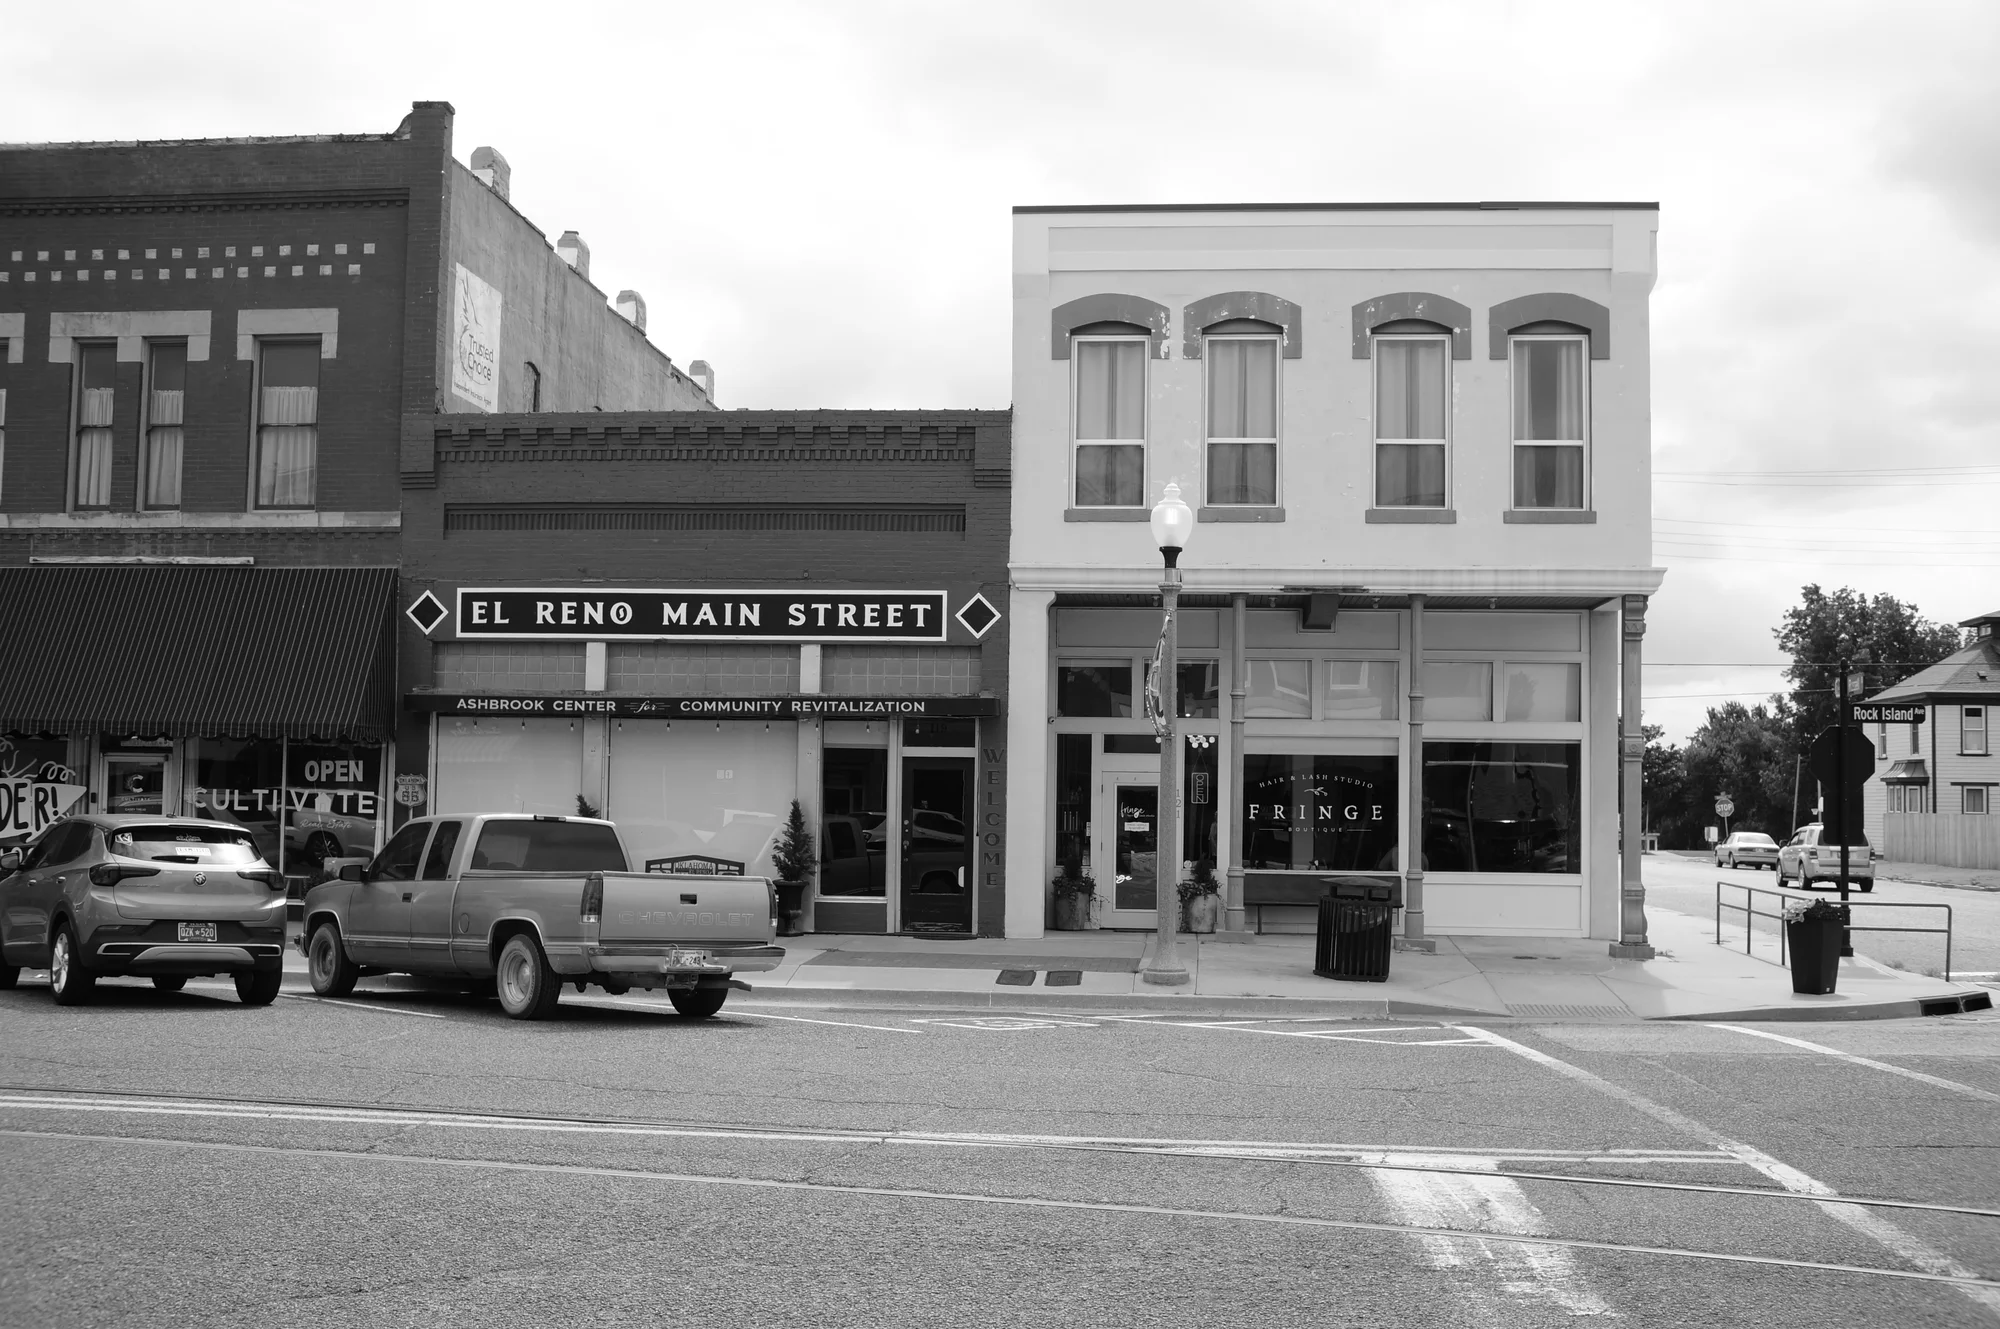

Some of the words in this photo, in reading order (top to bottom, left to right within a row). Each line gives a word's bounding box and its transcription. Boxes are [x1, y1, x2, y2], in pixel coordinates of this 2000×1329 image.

[469, 334, 494, 363] Trusted
[468, 352, 492, 381] Choice
[472, 601, 510, 625] EL
[536, 601, 633, 626] RENO
[662, 602, 762, 627] MAIN
[788, 604, 932, 628] STREET
[456, 698, 545, 711] ASHBROOK
[553, 700, 616, 711] CENTER
[633, 700, 658, 713] for
[679, 701, 783, 713] COMMUNITY
[792, 701, 926, 713] REVITALIZATION
[1853, 706, 1879, 721] Rock
[1882, 707, 1914, 721] Island
[1914, 707, 1926, 715] Ave
[304, 760, 364, 782] OPEN
[1195, 774, 1205, 803] OPEN
[1259, 776, 1285, 789] HAIR
[1334, 775, 1374, 790] STUDIO
[1120, 802, 1146, 819] fringe
[1249, 804, 1383, 821] FRINGE
[1716, 804, 1733, 812] STOP
[299, 816, 323, 829] Real
[325, 817, 353, 831] Estate
[982, 748, 1005, 887] WELCOME
[618, 911, 755, 927] CHEVROLET
